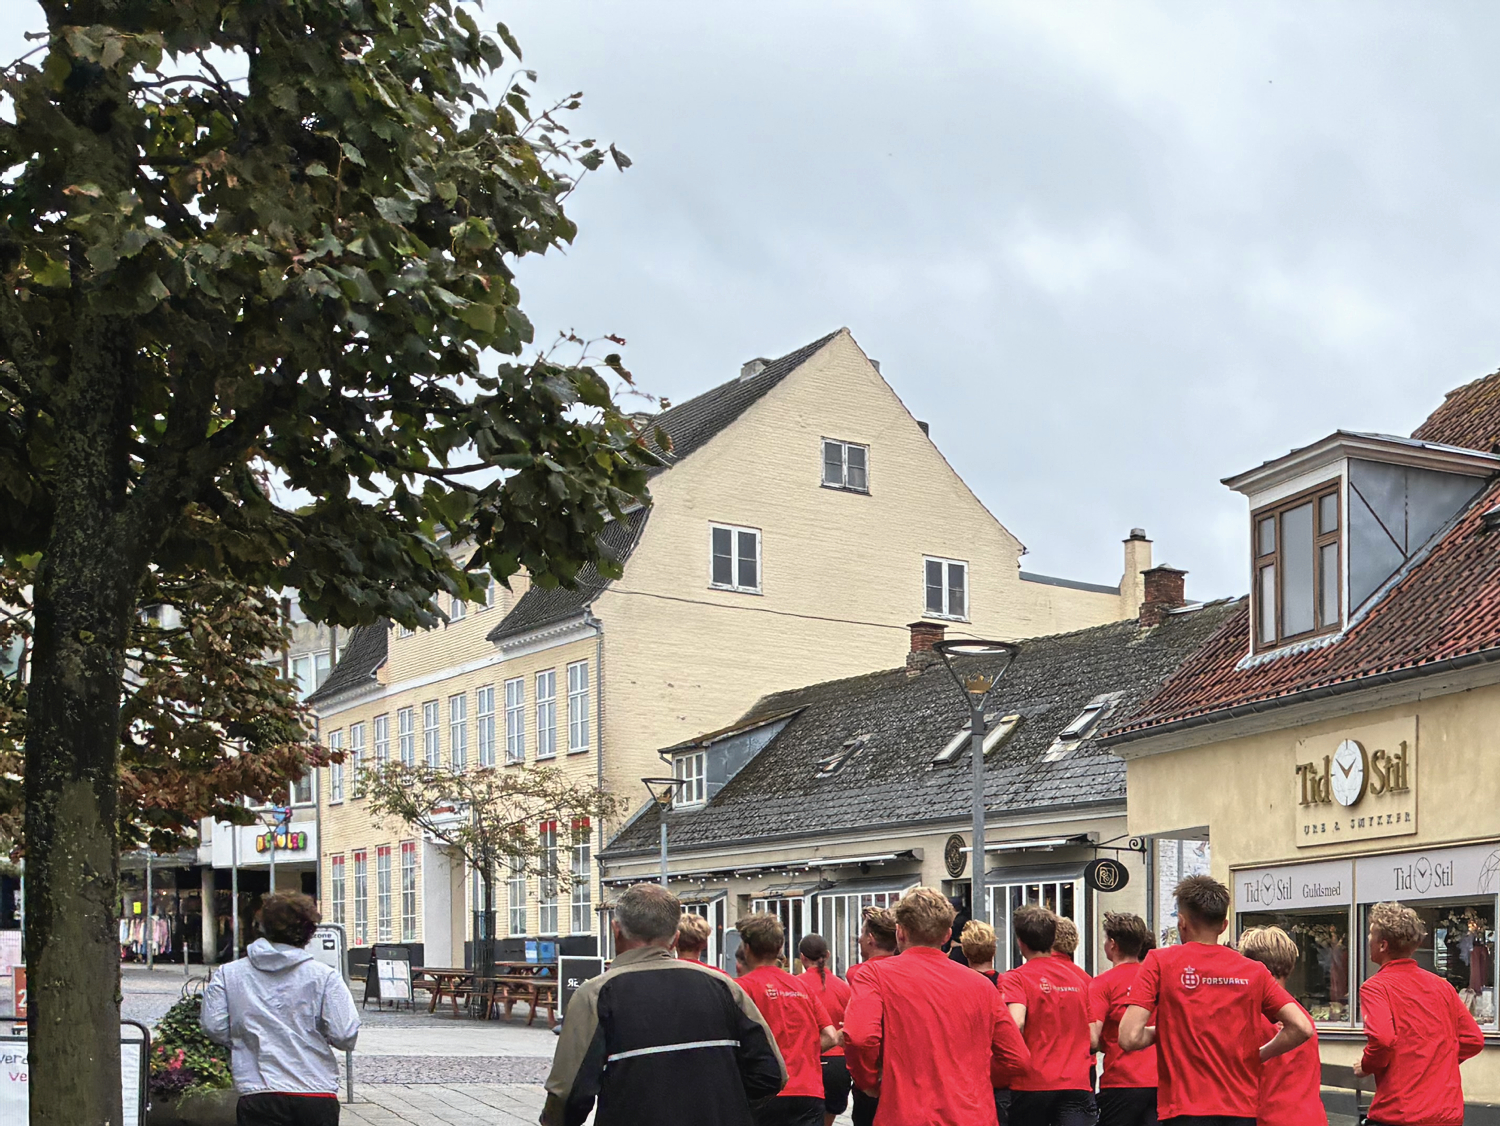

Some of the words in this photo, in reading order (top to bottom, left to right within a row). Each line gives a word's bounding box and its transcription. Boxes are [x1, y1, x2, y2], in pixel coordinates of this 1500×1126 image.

[1296, 755, 1332, 806] Tid
[1370, 740, 1409, 796] Stil
[1244, 880, 1260, 903] Tid
[1276, 876, 1293, 901] Stil
[1302, 881, 1341, 899] Guldsmed
[1393, 865, 1413, 891] Tid
[1434, 860, 1454, 888] Stil
[1202, 977, 1250, 985] FORSVARET
